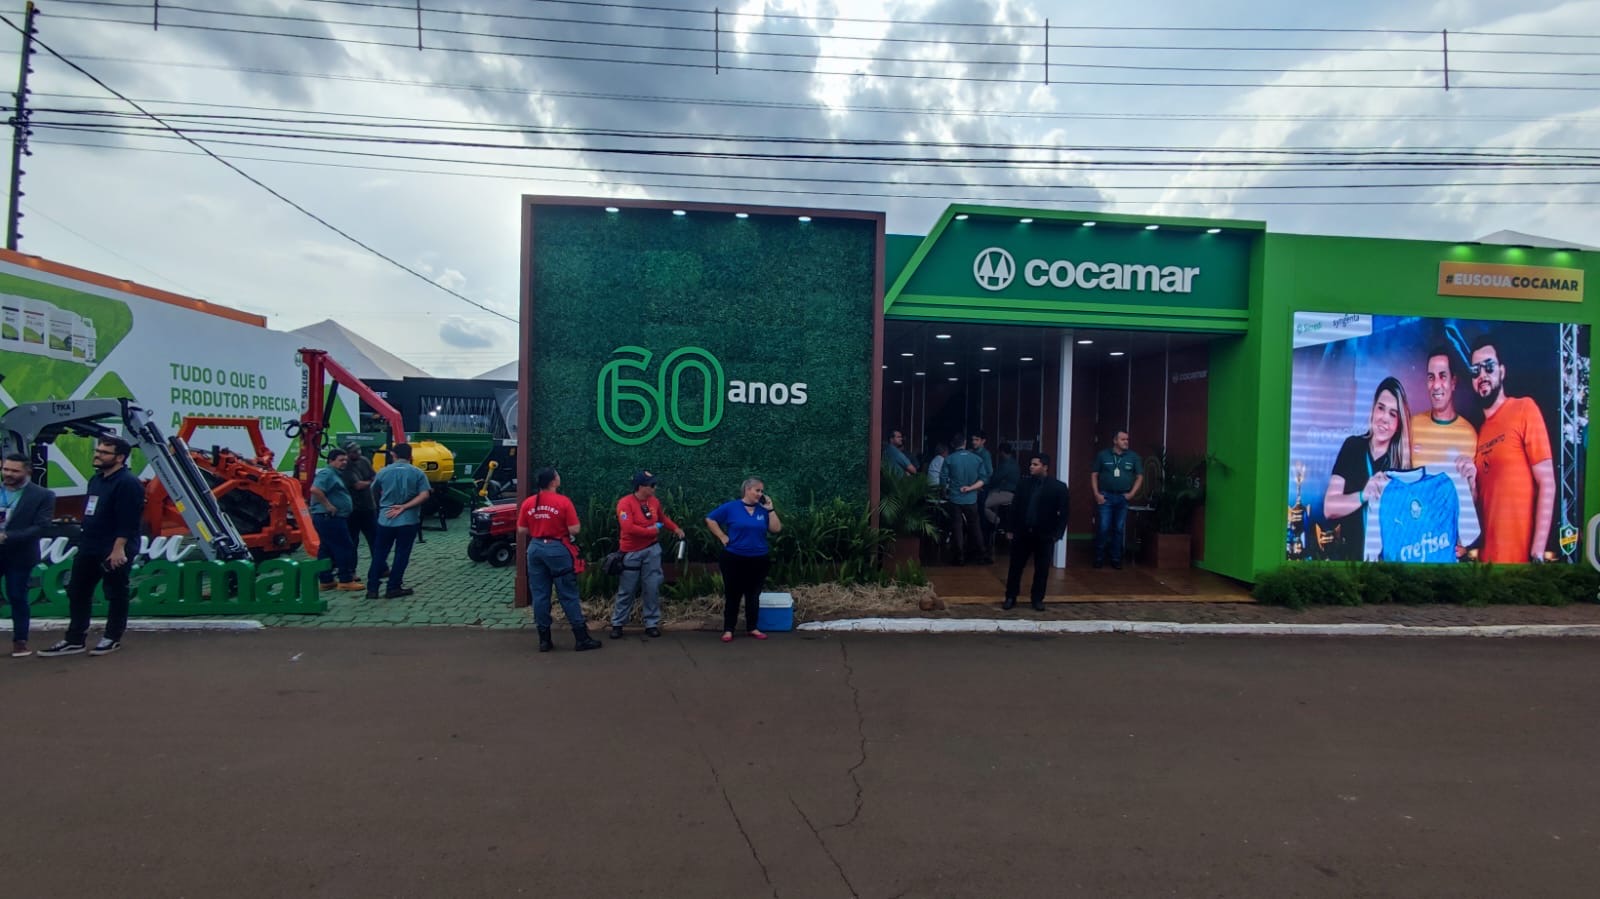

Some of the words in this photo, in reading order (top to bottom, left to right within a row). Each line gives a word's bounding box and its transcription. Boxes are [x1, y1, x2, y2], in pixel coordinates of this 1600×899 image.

[1023, 257, 1201, 294] cocamar
[1445, 272, 1578, 292] #EUSOUACOCAMAR
[170, 362, 212, 384] TUDO
[216, 369, 226, 386] O
[230, 371, 255, 389] QUE
[258, 375, 267, 390] O
[171, 386, 249, 409] PRODUTOR
[252, 395, 301, 413] PRECISA,
[596, 344, 726, 448] 60
[727, 378, 809, 406] anos
[171, 411, 182, 428] A
[1400, 531, 1450, 563] crefisa
